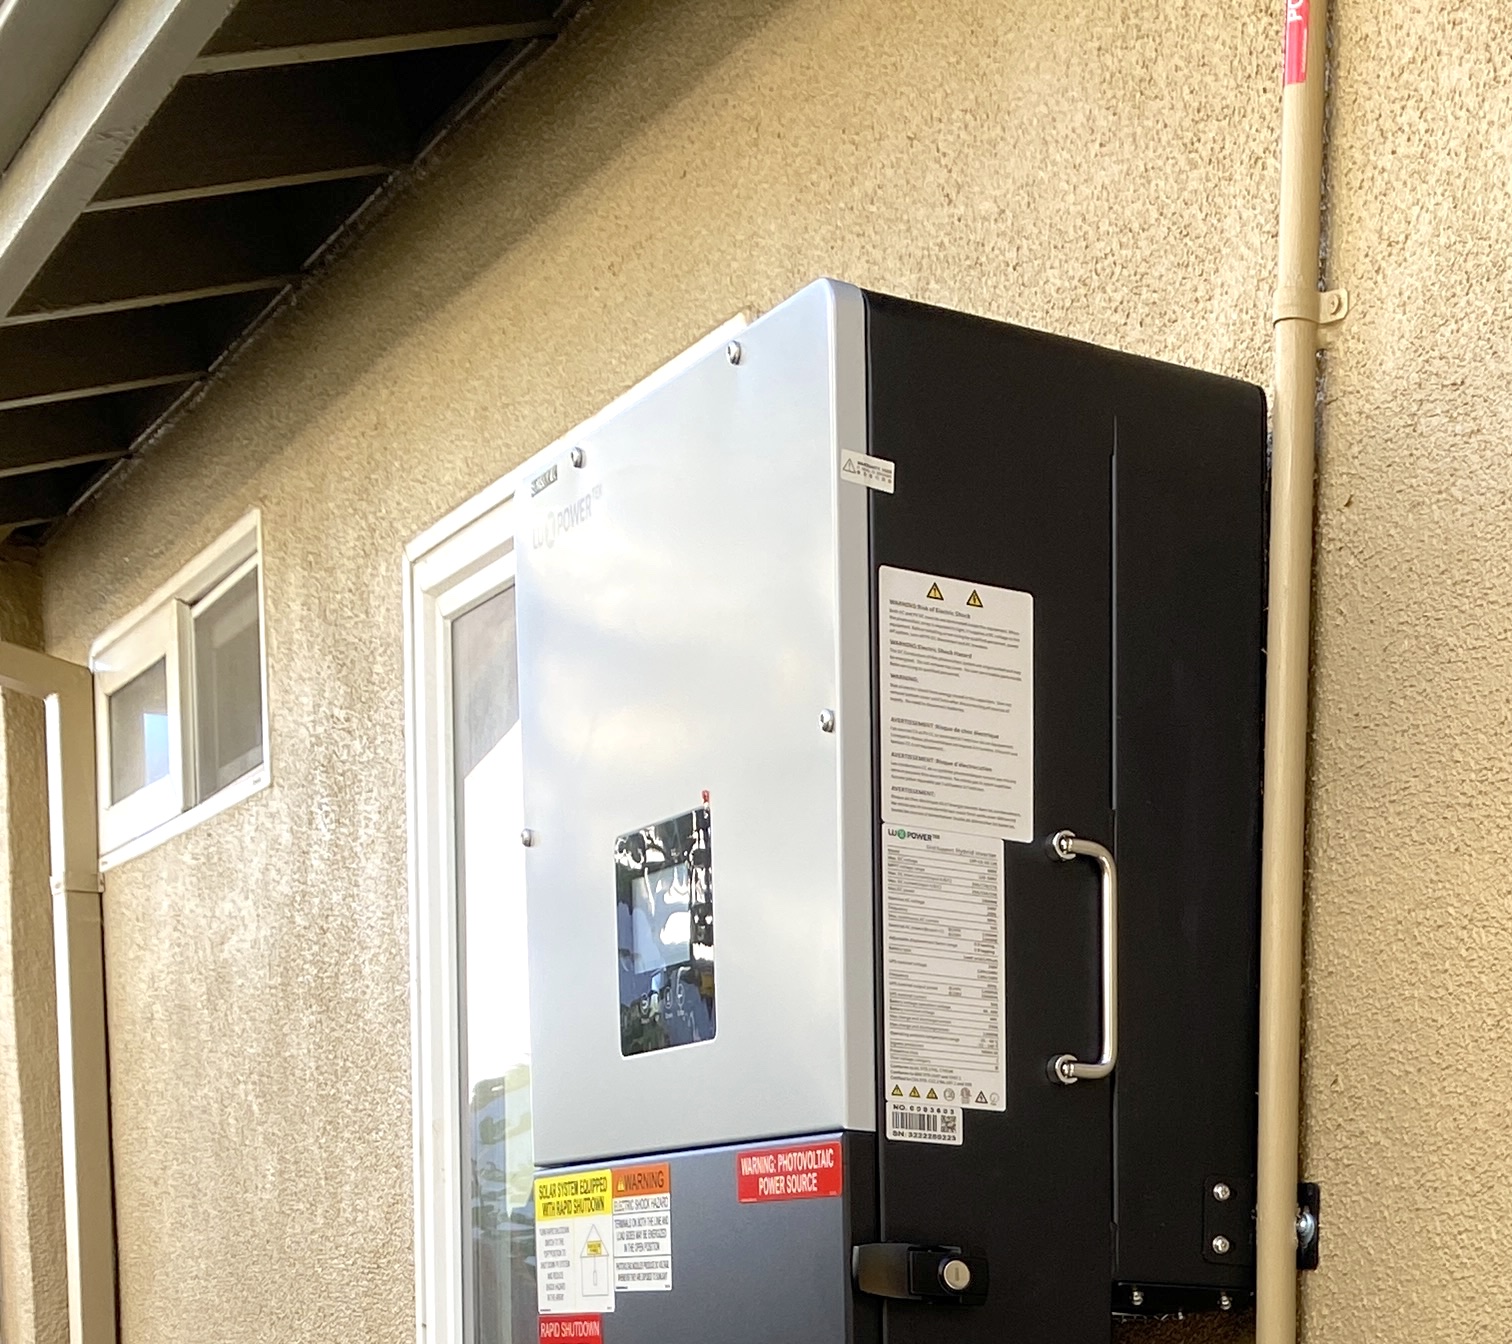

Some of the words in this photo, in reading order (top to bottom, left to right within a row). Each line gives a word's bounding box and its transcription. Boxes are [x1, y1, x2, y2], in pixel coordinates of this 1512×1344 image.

[741, 1155, 776, 1176] WARNING:
[778, 1148, 834, 1172] PHOTOVOLTAIC
[539, 1183, 556, 1200] SOLAR
[558, 1181, 578, 1198] SYSTEM
[580, 1177, 608, 1195] EQUIPPED
[625, 1171, 664, 1190] WARNING
[759, 1176, 785, 1196] POWER
[786, 1173, 817, 1193] SOURCE
[542, 1201, 555, 1216] WITH
[557, 1199, 572, 1215] RAPID
[574, 1196, 605, 1214] SHUTDOWN
[614, 1200, 634, 1212] ELECTRIC
[635, 1198, 649, 1209] SHOCK
[651, 1196, 668, 1209] HAZARD
[541, 1322, 560, 1338] RAPID
[561, 1321, 599, 1337] SHUTDOWN
